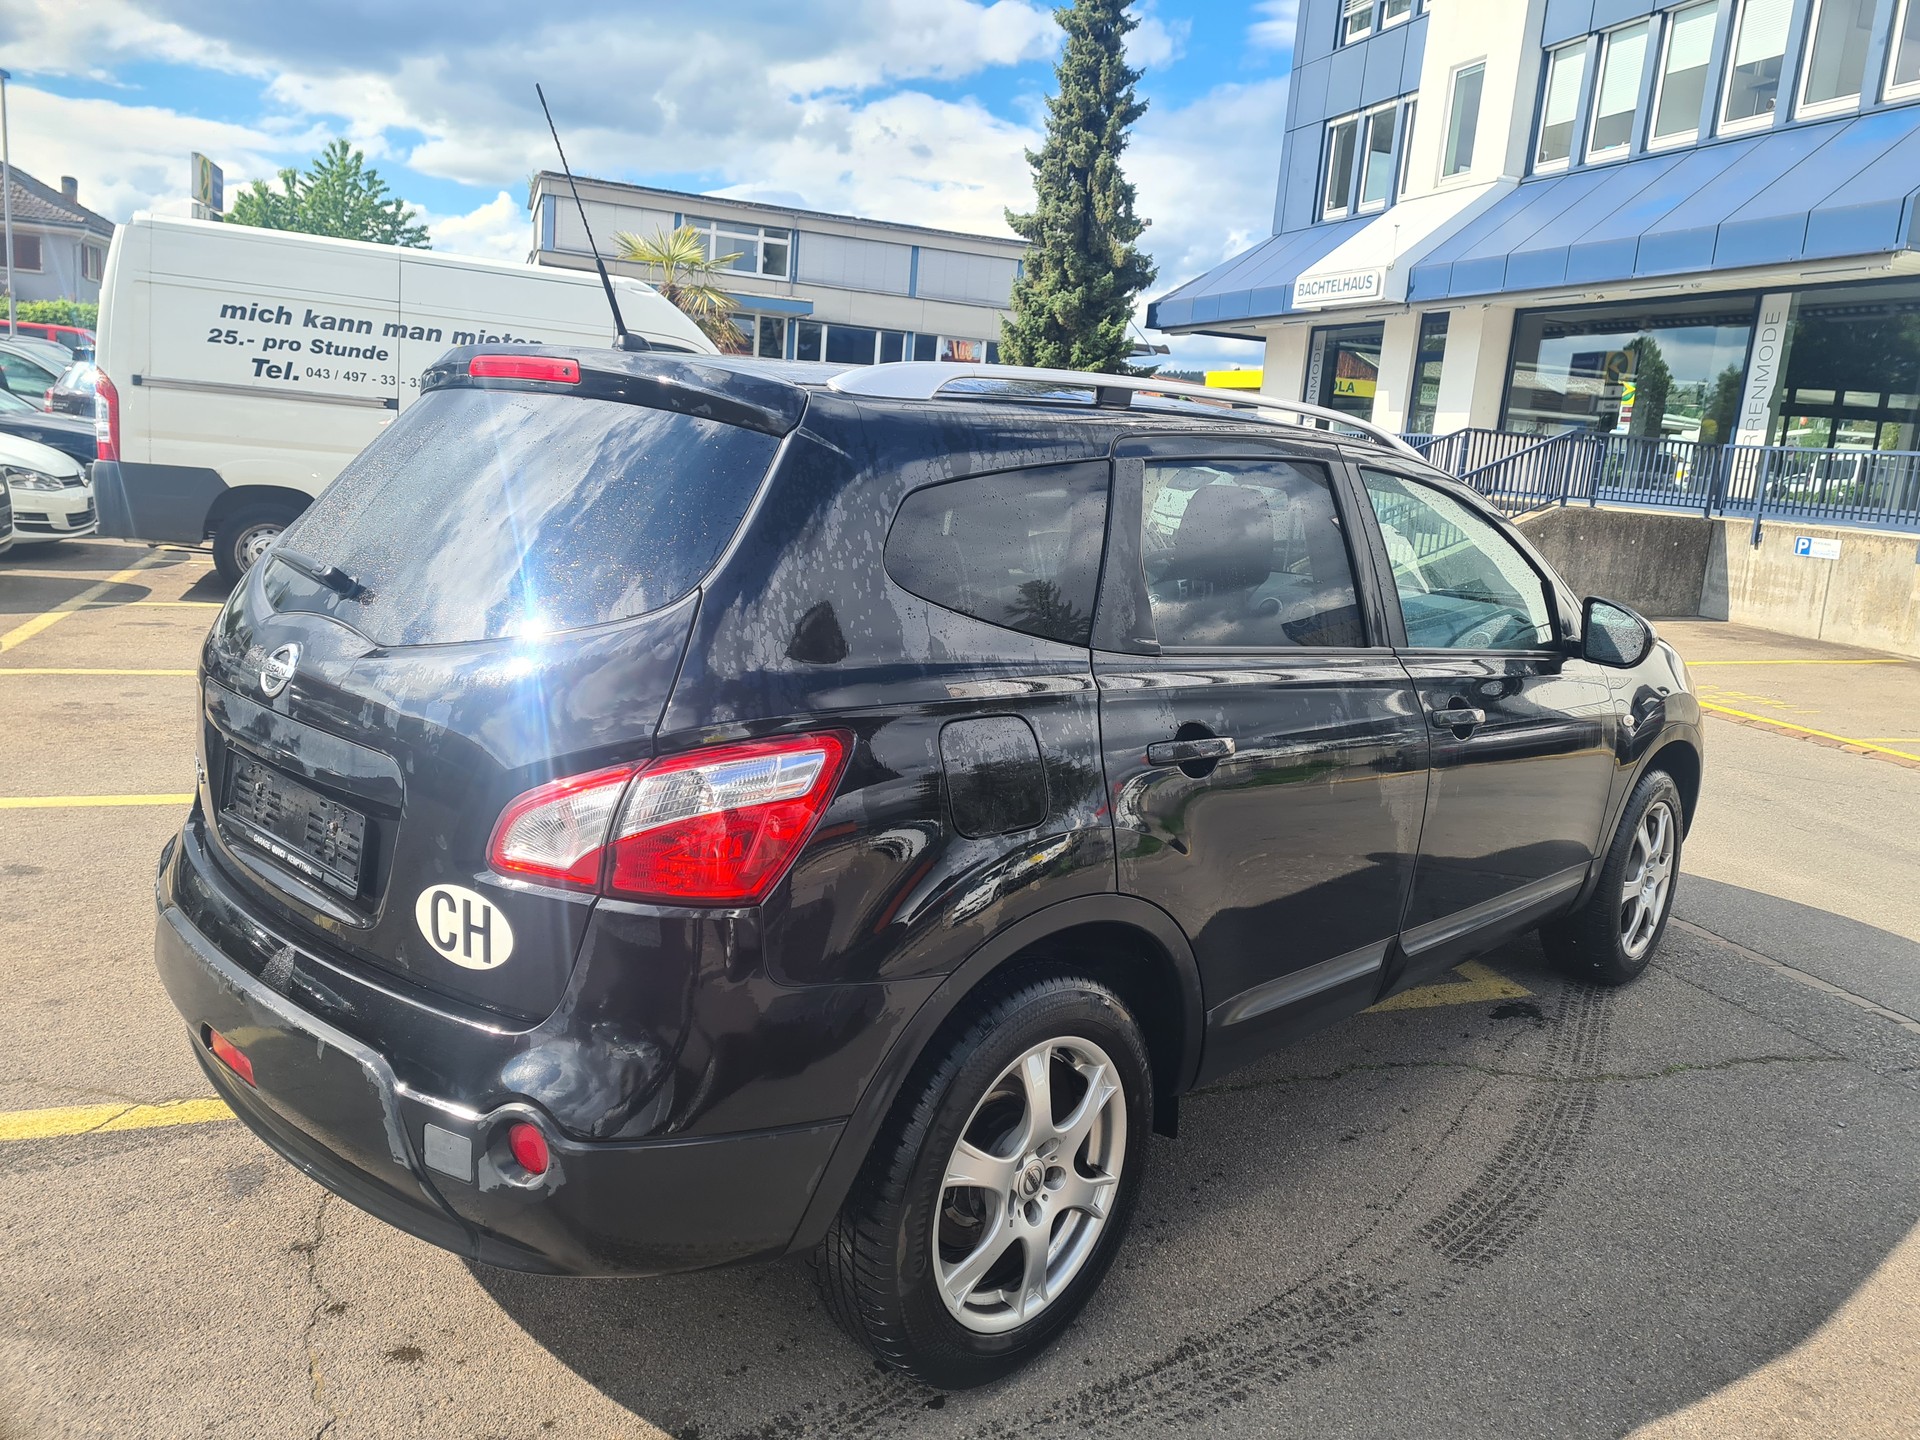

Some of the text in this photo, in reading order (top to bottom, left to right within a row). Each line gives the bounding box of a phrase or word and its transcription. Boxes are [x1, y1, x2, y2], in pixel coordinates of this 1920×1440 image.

[1298, 275, 1373, 297] BACHTELHAUS
[220, 303, 543, 345] mich kann man miet
[207, 328, 389, 361] 25.- pro Stunde
[252, 358, 300, 381] Tel.
[306, 367, 330, 380] 043
[343, 371, 367, 383] 497
[380, 375, 396, 386] 33
[1797, 538, 1809, 554] P
[431, 890, 491, 964] CH
